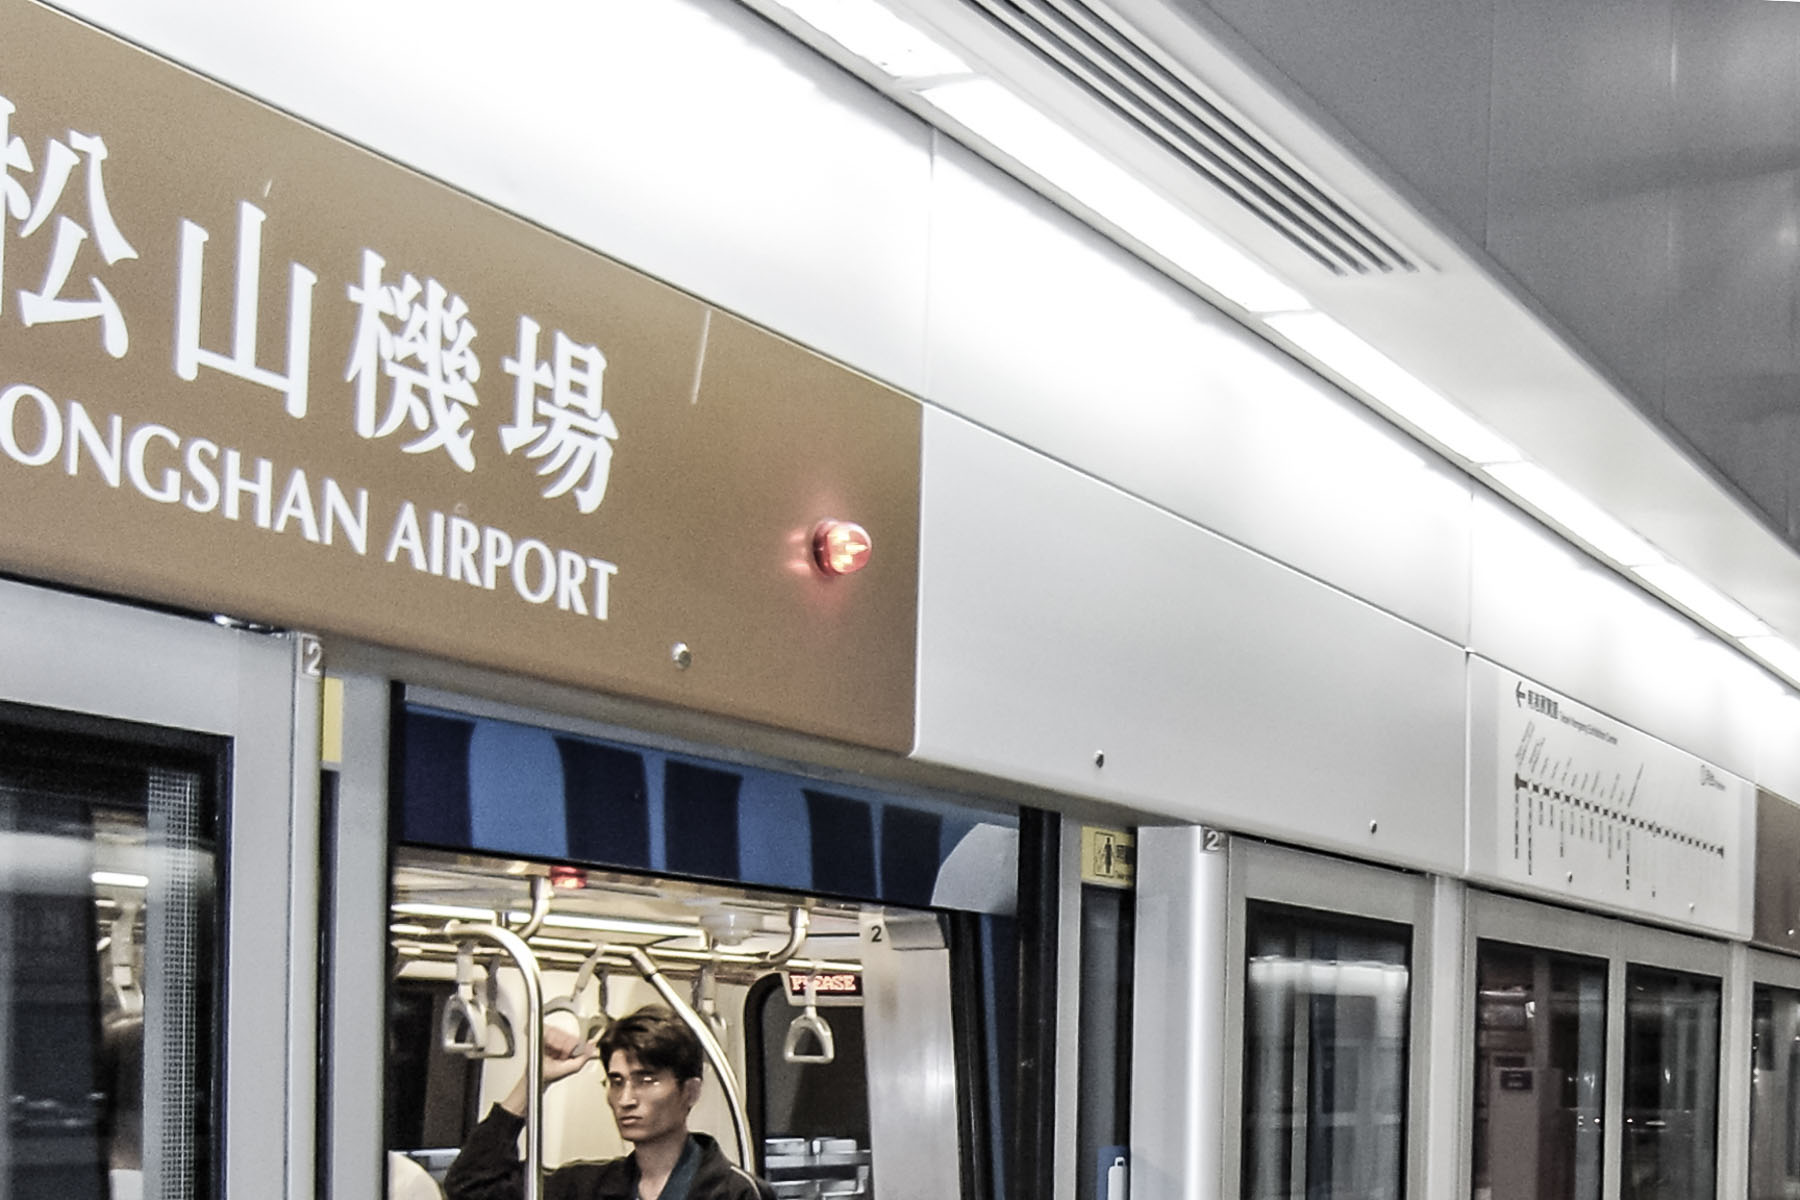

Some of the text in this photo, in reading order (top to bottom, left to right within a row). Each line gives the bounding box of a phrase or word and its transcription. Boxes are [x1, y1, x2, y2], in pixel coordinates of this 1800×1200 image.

[0, 96, 619, 515] 松山機場
[386, 501, 618, 620] AIRPORT
[307, 641, 321, 676] 2
[1205, 830, 1220, 850] 2
[870, 925, 882, 942] 2
